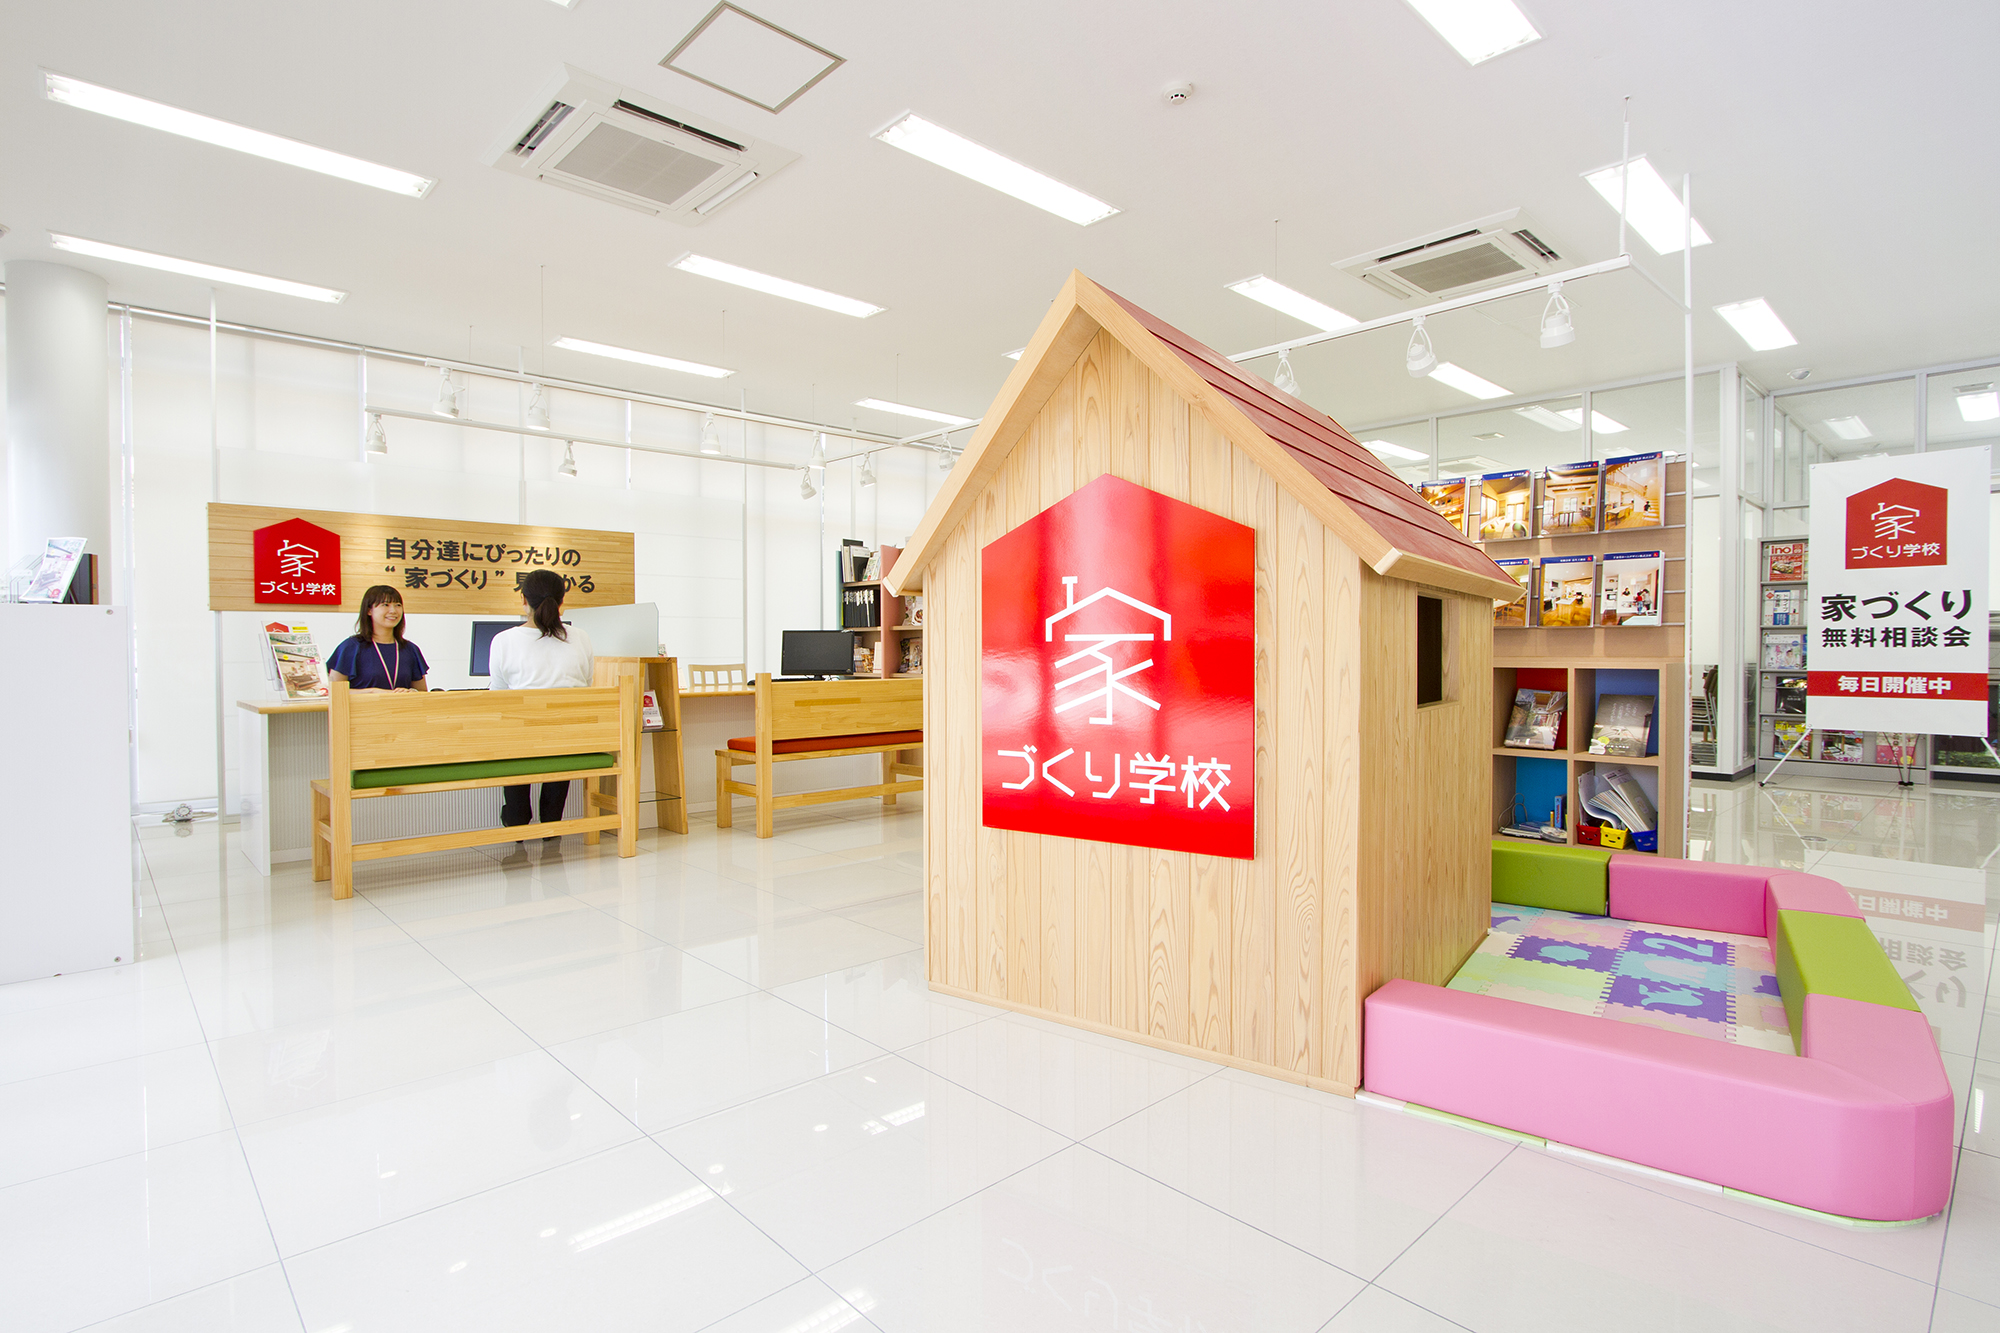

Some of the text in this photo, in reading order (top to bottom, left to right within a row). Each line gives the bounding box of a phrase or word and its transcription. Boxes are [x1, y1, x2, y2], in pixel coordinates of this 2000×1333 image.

[1871, 503, 1920, 540] 家
[277, 539, 319, 577] 家
[385, 537, 582, 567] 自分達にぴったりの
[1851, 542, 1941, 559] づくり学校
[260, 581, 336, 596] づくり学校
[1820, 589, 1972, 622] 家づくり
[1045, 576, 1171, 725] 家
[1821, 625, 1972, 648] 無料相談会
[1838, 675, 1952, 695] 毎日開催中
[998, 744, 1231, 812] づくり学校
